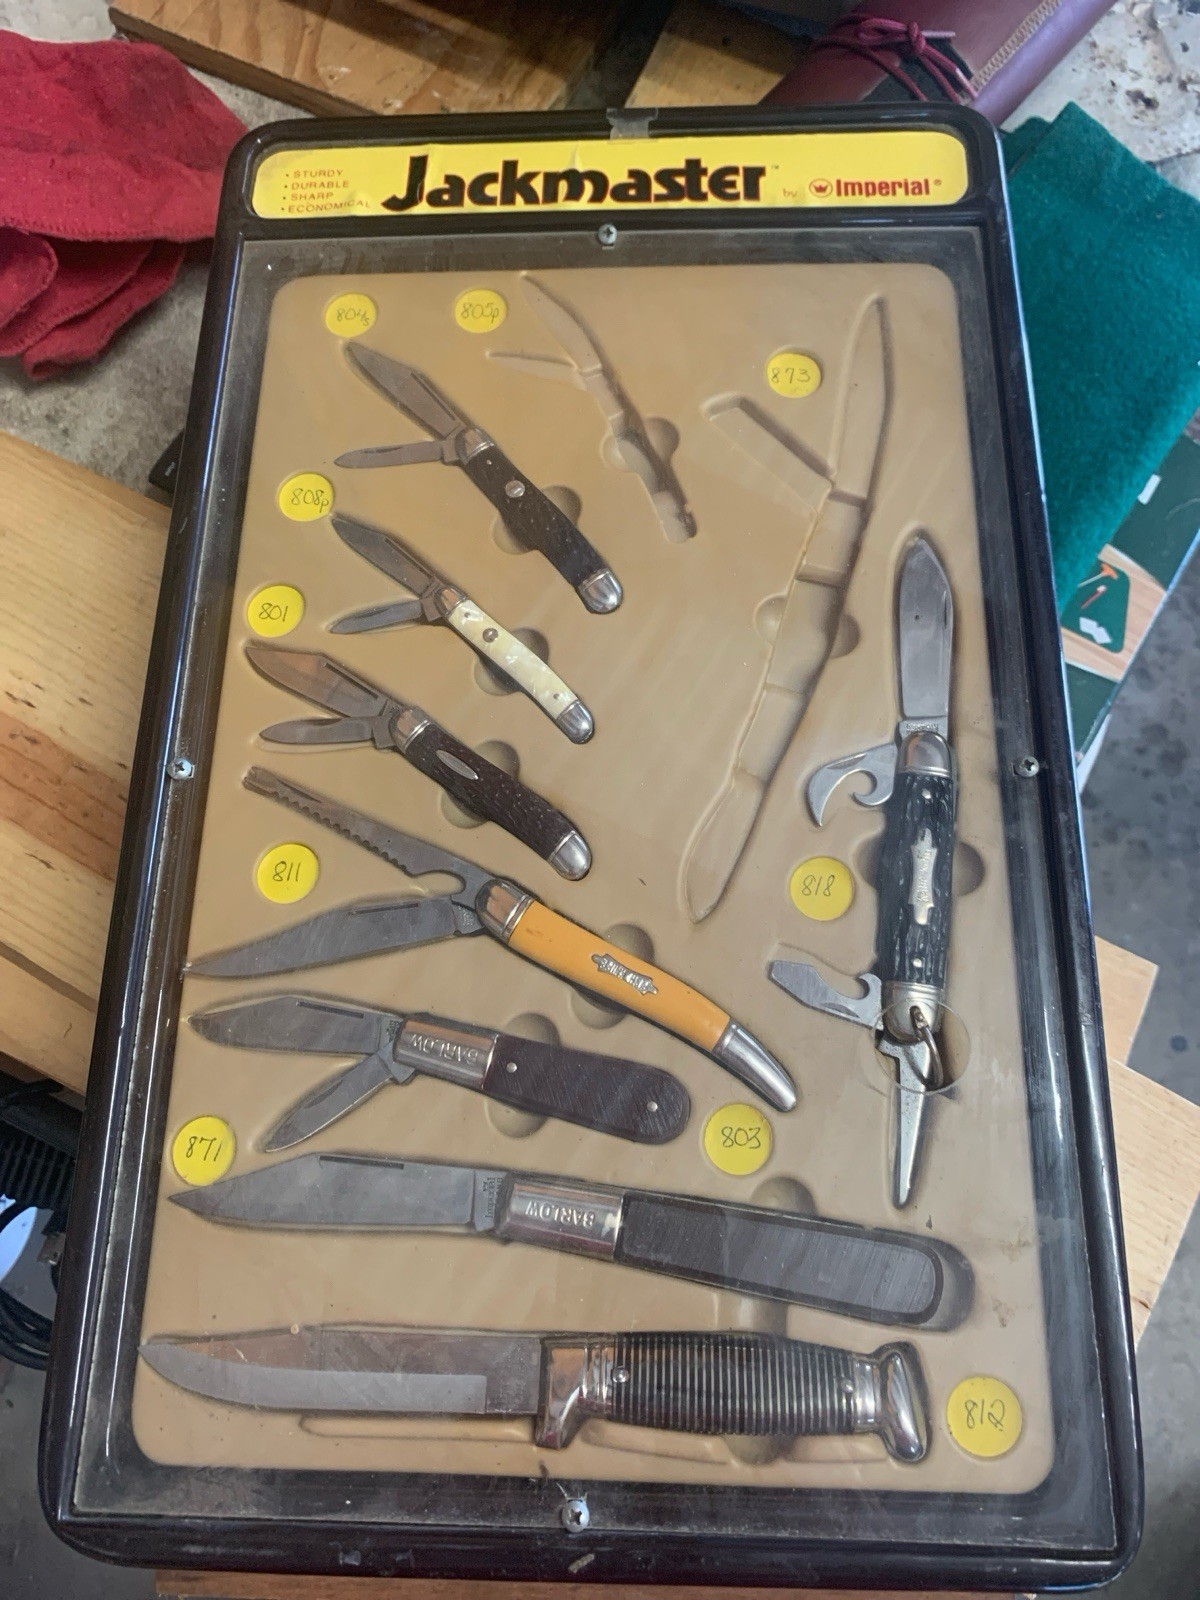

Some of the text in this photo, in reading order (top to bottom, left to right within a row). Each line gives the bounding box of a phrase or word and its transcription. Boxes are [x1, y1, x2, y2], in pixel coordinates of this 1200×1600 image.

[293, 169, 344, 179] STURDY
[381, 155, 766, 212] Jackmaster
[291, 180, 349, 190] DURABLE
[782, 178, 931, 199] by Imperial
[287, 199, 371, 213] ECONOMICAL
[290, 191, 334, 202] SHARP
[771, 367, 811, 383] 873
[258, 603, 288, 621] 801
[272, 861, 301, 882] 811
[801, 875, 835, 897] 818
[185, 1136, 224, 1162] 871
[720, 1127, 762, 1150] 803
[525, 1201, 595, 1228] BARLOW
[964, 1399, 1005, 1432] 812
